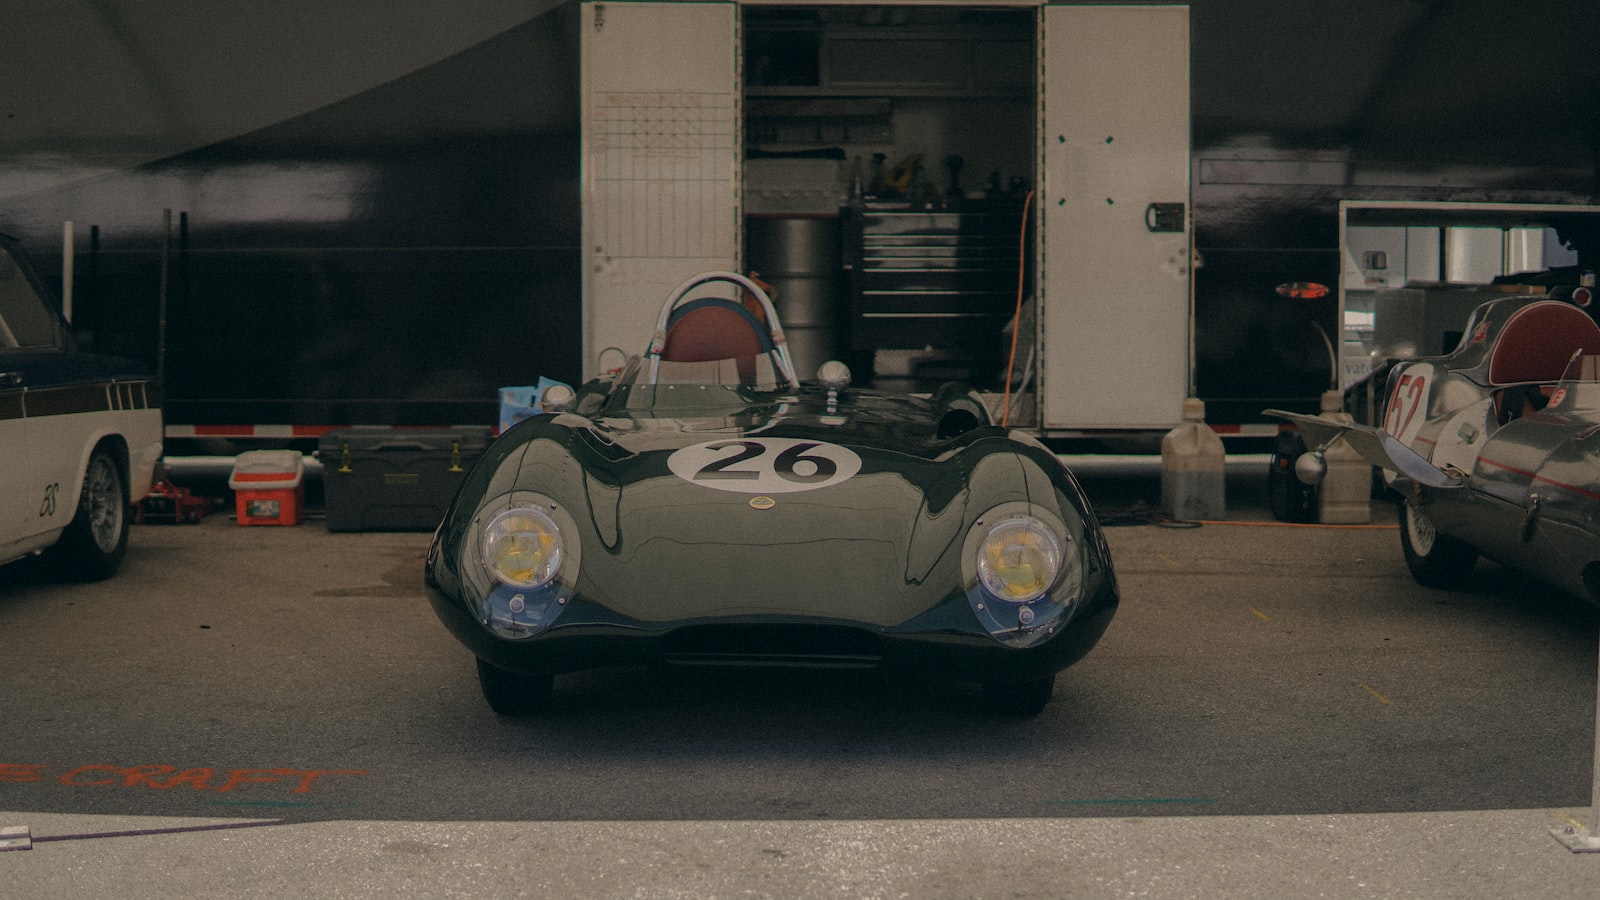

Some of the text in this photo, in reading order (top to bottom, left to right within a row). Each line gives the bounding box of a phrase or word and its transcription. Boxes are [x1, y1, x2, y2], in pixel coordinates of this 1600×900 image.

[1384, 374, 1425, 439] 52
[693, 441, 837, 483] 26
[59, 764, 368, 794] CRAFT
